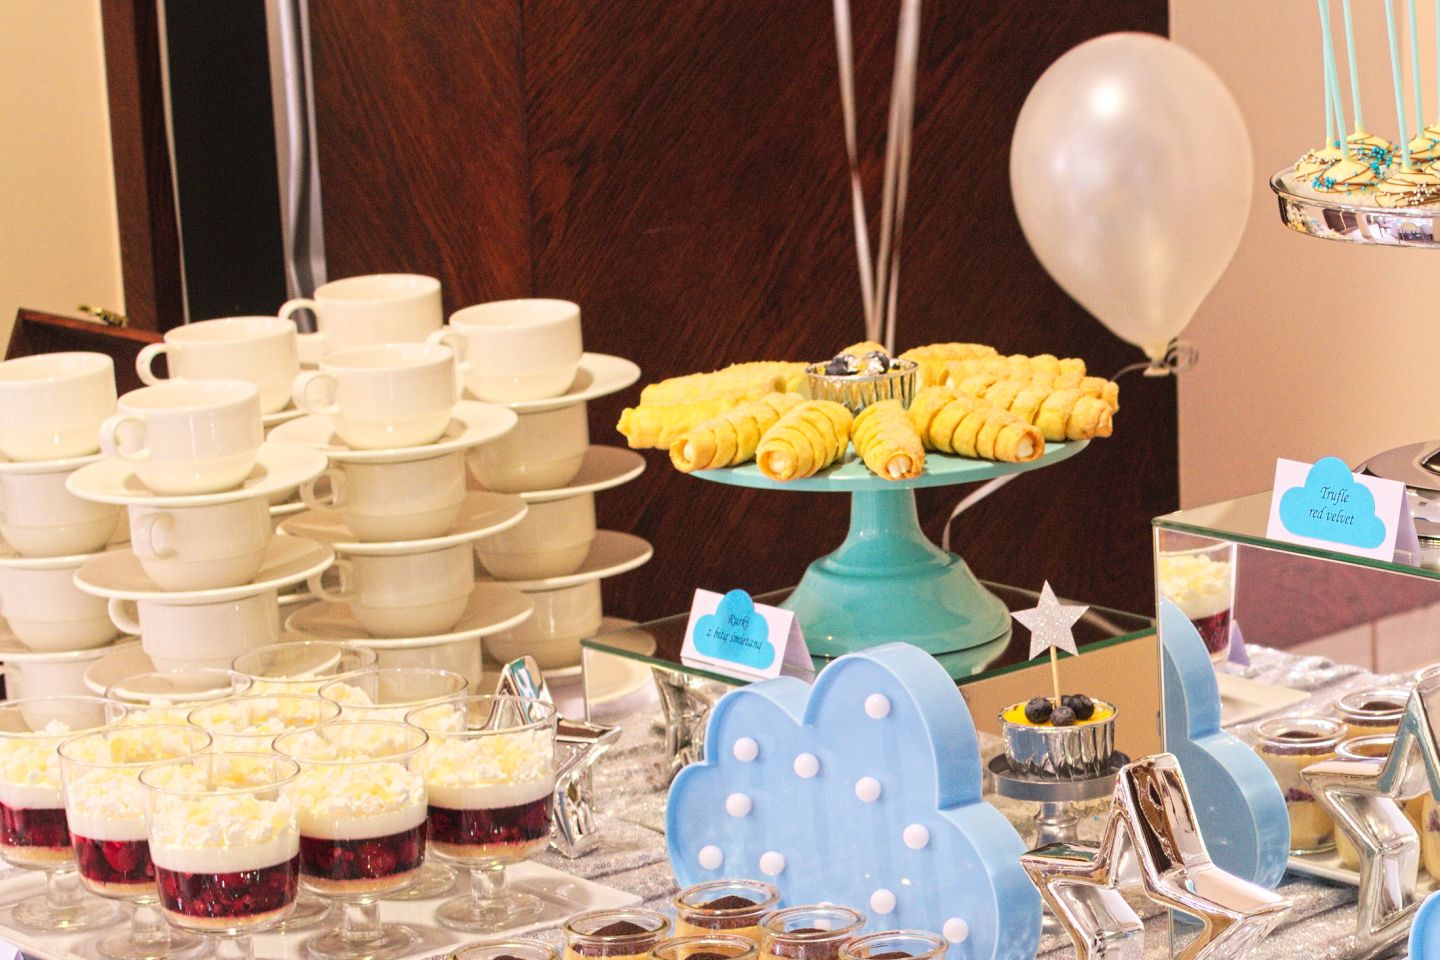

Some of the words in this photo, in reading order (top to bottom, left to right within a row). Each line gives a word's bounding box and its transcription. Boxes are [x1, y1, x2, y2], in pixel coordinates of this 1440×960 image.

[1320, 486, 1350, 506] Trufle
[1309, 506, 1326, 520] red
[1326, 509, 1354, 526] velvet
